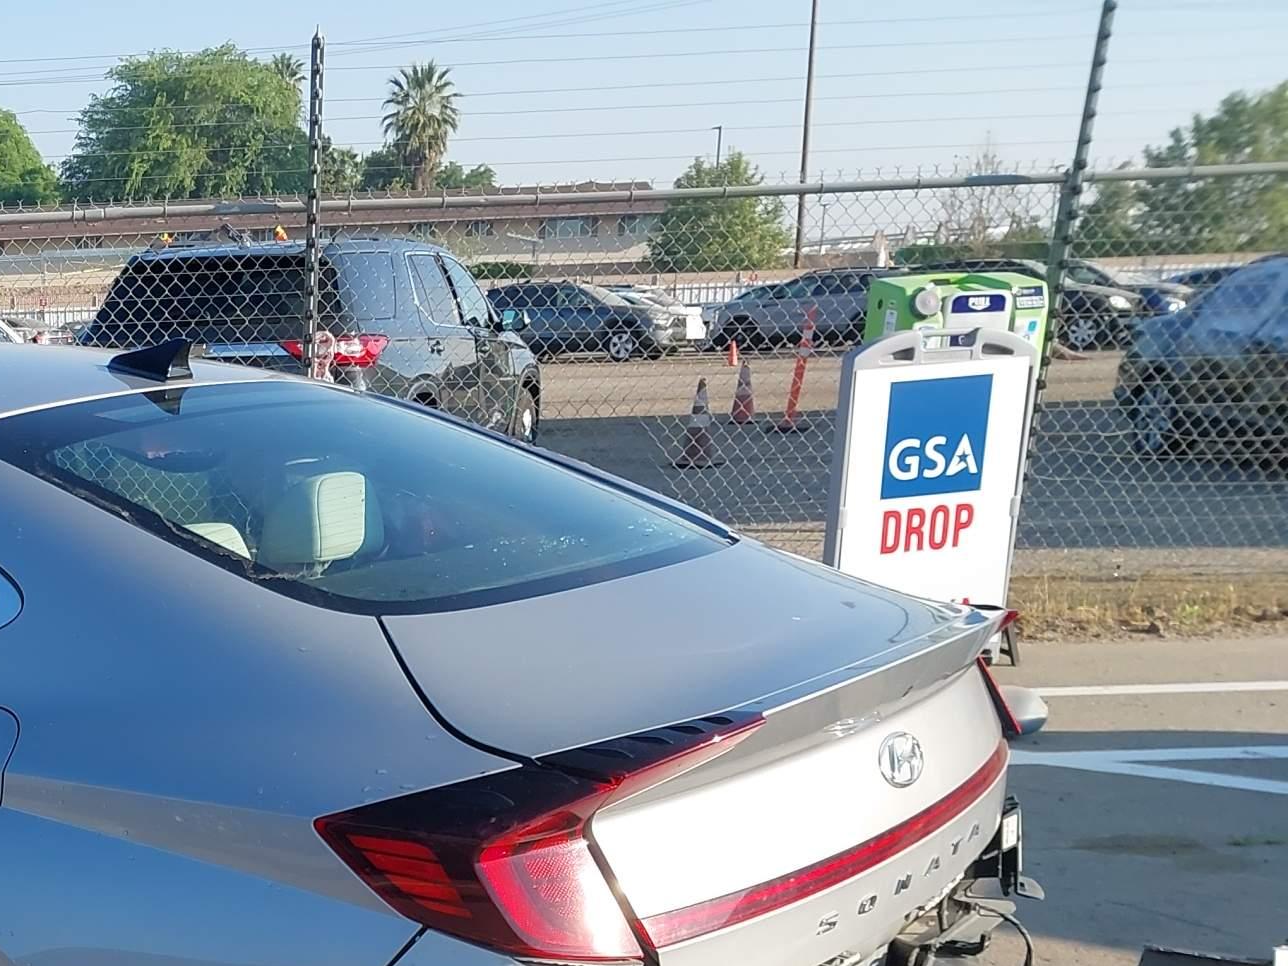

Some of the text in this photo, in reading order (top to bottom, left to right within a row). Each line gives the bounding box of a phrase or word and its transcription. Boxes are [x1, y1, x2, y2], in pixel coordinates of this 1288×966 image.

[888, 433, 979, 481] GSA
[879, 503, 975, 555] DROP
[815, 822, 981, 936] SONATA
